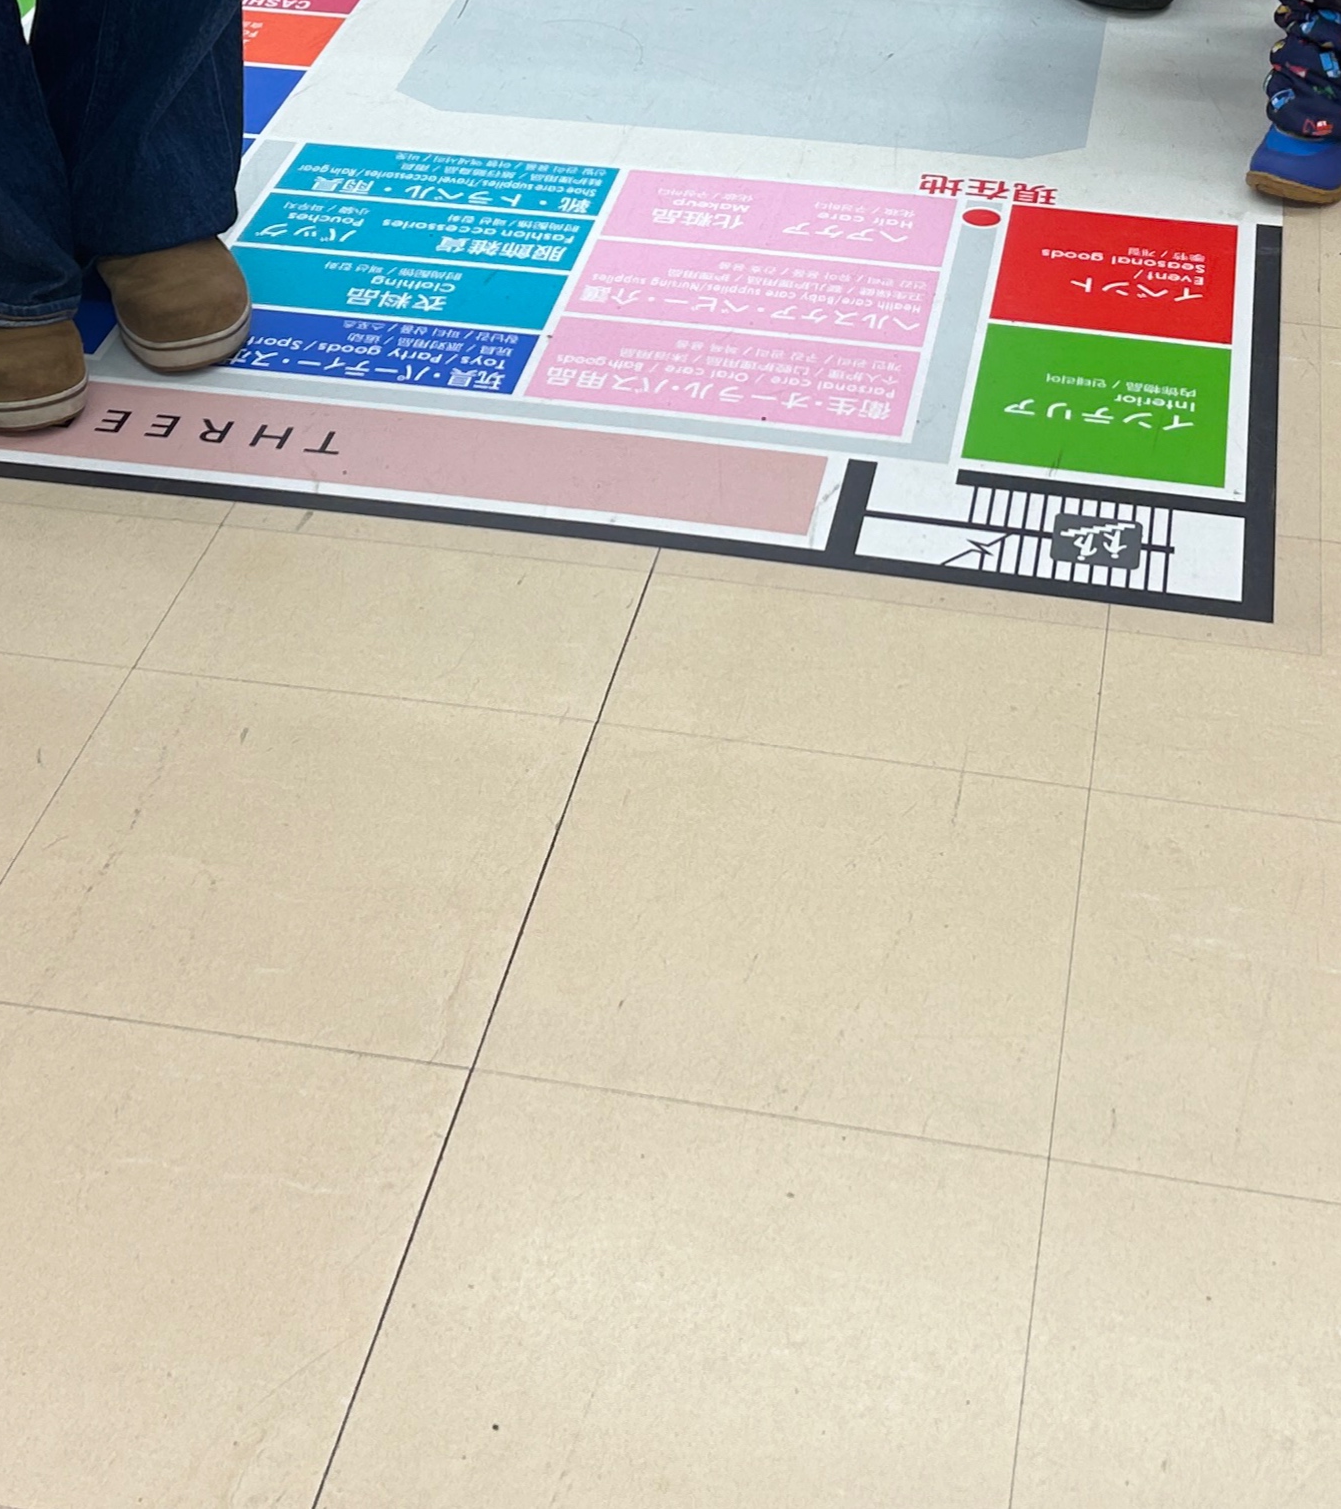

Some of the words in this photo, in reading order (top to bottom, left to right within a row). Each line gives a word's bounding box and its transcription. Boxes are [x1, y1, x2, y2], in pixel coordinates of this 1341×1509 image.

[297, 164, 329, 172] gear
[534, 184, 564, 192] care
[565, 186, 596, 196] Shoe
[920, 174, 1055, 204] 現在地
[312, 177, 589, 214] 靴・トラベル・雨具
[673, 198, 749, 212] Makeup
[288, 212, 363, 226] Pouches
[652, 208, 742, 228] 化粧品
[817, 212, 864, 222] care
[872, 217, 912, 228] Hair
[255, 223, 355, 241] バッグ
[382, 219, 496, 234] accessories
[782, 222, 907, 242] ヘアケア
[501, 230, 574, 243] Fashion
[436, 236, 565, 261] 服飾雑貨
[1041, 249, 1103, 260] goods
[1111, 256, 1204, 273] Seasonal
[371, 275, 455, 292] Clothing
[592, 273, 645, 284] supplies
[1147, 271, 1203, 285] Event
[765, 289, 795, 298] care
[1071, 278, 1201, 301] イベント
[347, 288, 445, 310] 衣料品
[580, 285, 917, 329] ヘルスケア・ベビー・介護
[877, 301, 920, 312] Health
[247, 336, 302, 349] Sport
[318, 342, 381, 354] goods
[388, 348, 442, 363] Party
[461, 355, 504, 369] Toys
[557, 354, 606, 365] goods
[608, 359, 643, 371] Bath
[664, 364, 704, 375] care
[710, 370, 748, 381] Oral
[770, 375, 811, 386] care
[547, 367, 888, 418] 衛生・オーラル・バス用品
[1115, 394, 1194, 411] Interior
[1004, 399, 1192, 429] インテリア
